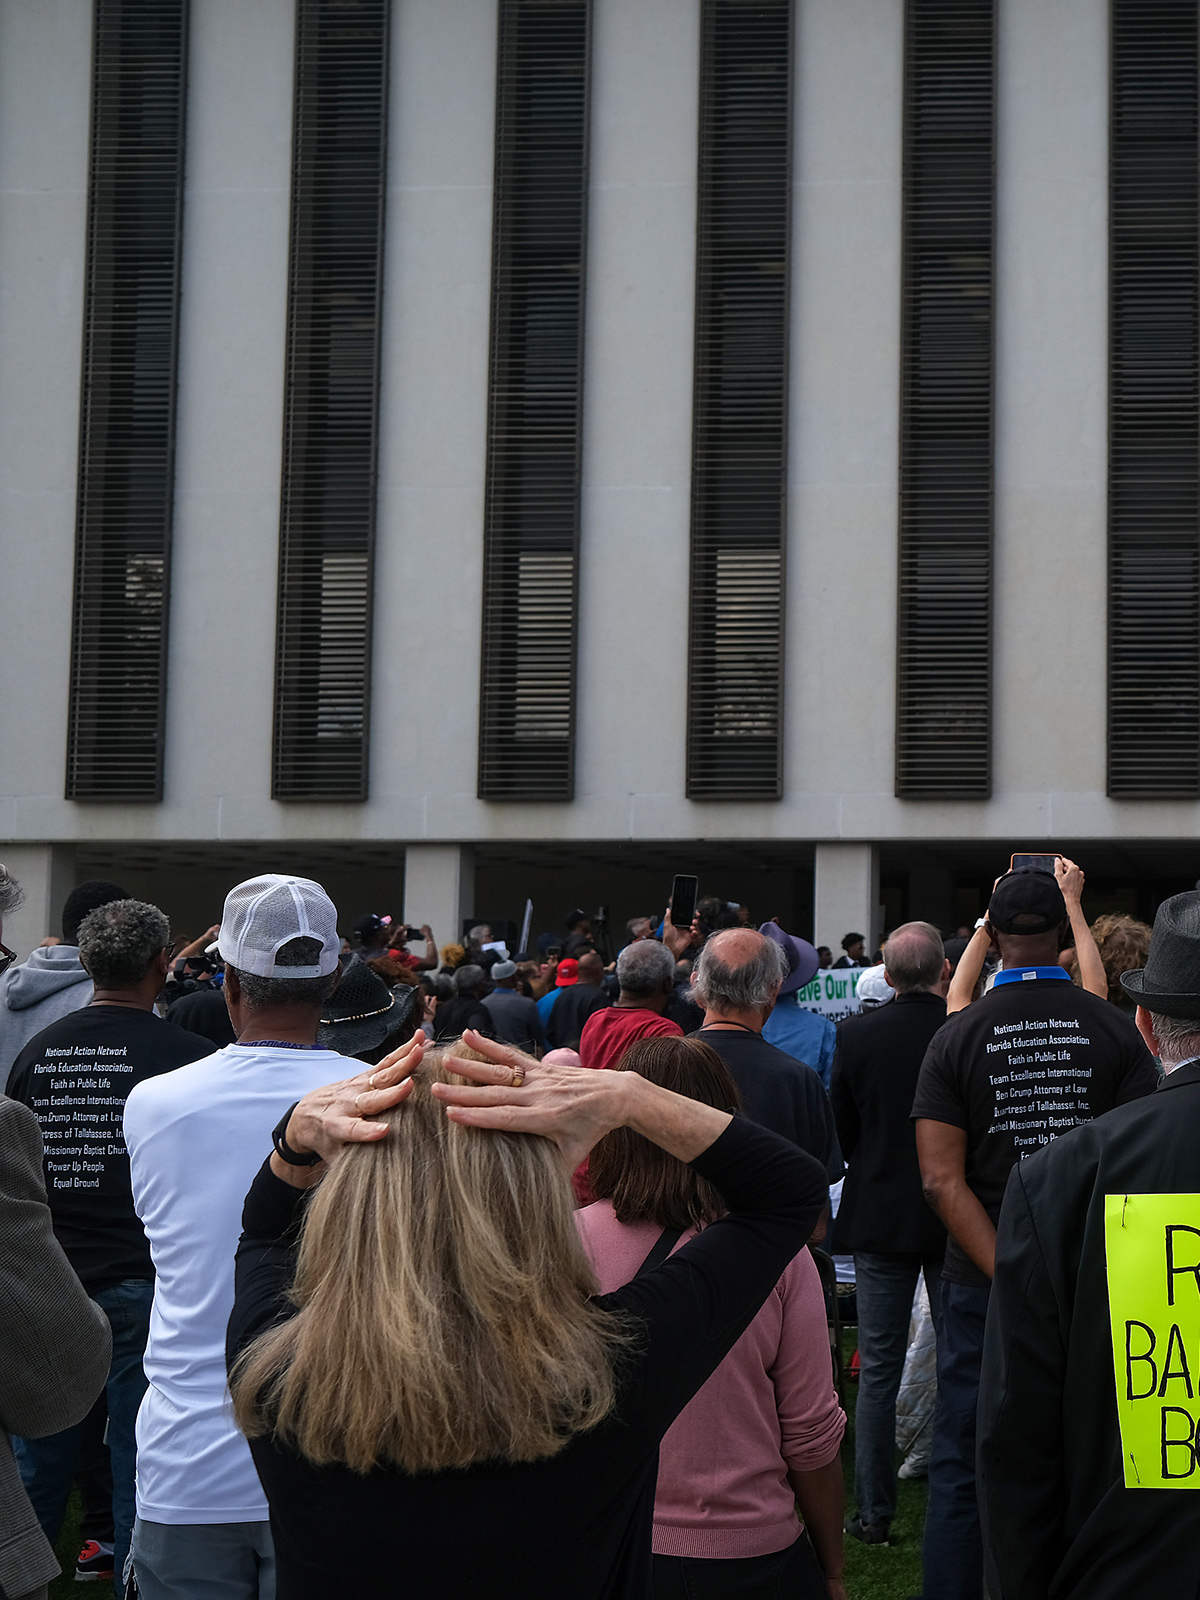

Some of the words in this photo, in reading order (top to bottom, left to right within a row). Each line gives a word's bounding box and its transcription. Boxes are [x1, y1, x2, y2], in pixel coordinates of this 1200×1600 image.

[797, 979, 821, 1002] ave
[826, 974, 847, 1000] Our
[994, 1021, 1023, 1035] National
[1025, 1021, 1047, 1030] Action
[1049, 1019, 1079, 1028] Network
[986, 1040, 1011, 1054] Florida
[1013, 1037, 1047, 1048] Education
[1049, 1035, 1090, 1045] Association
[45, 1046, 73, 1057] National
[74, 1046, 96, 1056] Action
[97, 1046, 127, 1056] Network
[1008, 1054, 1025, 1065] Faith
[1027, 1054, 1033, 1063] in
[1035, 1052, 1056, 1062] Public
[1058, 1050, 1071, 1060] Life
[34, 1063, 56, 1074] Florida
[58, 1062, 91, 1072] Education
[93, 1062, 133, 1072] Association
[989, 1076, 1009, 1085] Team
[1010, 1070, 1045, 1081] Excellence
[1047, 1068, 1092, 1077] International
[50, 1079, 67, 1089] Faith
[69, 1080, 75, 1088] in
[77, 1078, 97, 1088] Public
[99, 1078, 111, 1088] Life
[996, 1091, 1008, 1100] Ben
[1010, 1088, 1032, 1097] Crump
[1034, 1085, 1063, 1095] Attorney
[1065, 1084, 1071, 1093] at
[1073, 1084, 1087, 1093] Law
[51, 1096, 85, 1105] Excellence
[87, 1095, 126, 1105] Internationa
[1028, 1102, 1034, 1111] of
[1078, 1100, 1090, 1109] Inc.
[73, 1112, 99, 1123] Attorney
[100, 1113, 108, 1121] at
[1010, 1120, 1047, 1130] Missionary
[1049, 1116, 1074, 1128] Baptist
[65, 1128, 72, 1138] of
[1014, 1136, 1037, 1146] Power
[1038, 1134, 1048, 1145] Up
[44, 1146, 82, 1156] Missionary
[84, 1145, 105, 1156] Baptist
[108, 1145, 126, 1154] Chur
[48, 1162, 71, 1171] Power
[72, 1161, 81, 1172] Up
[83, 1161, 105, 1173] People
[54, 1178, 72, 1189] Equal
[74, 1177, 99, 1188] Ground
